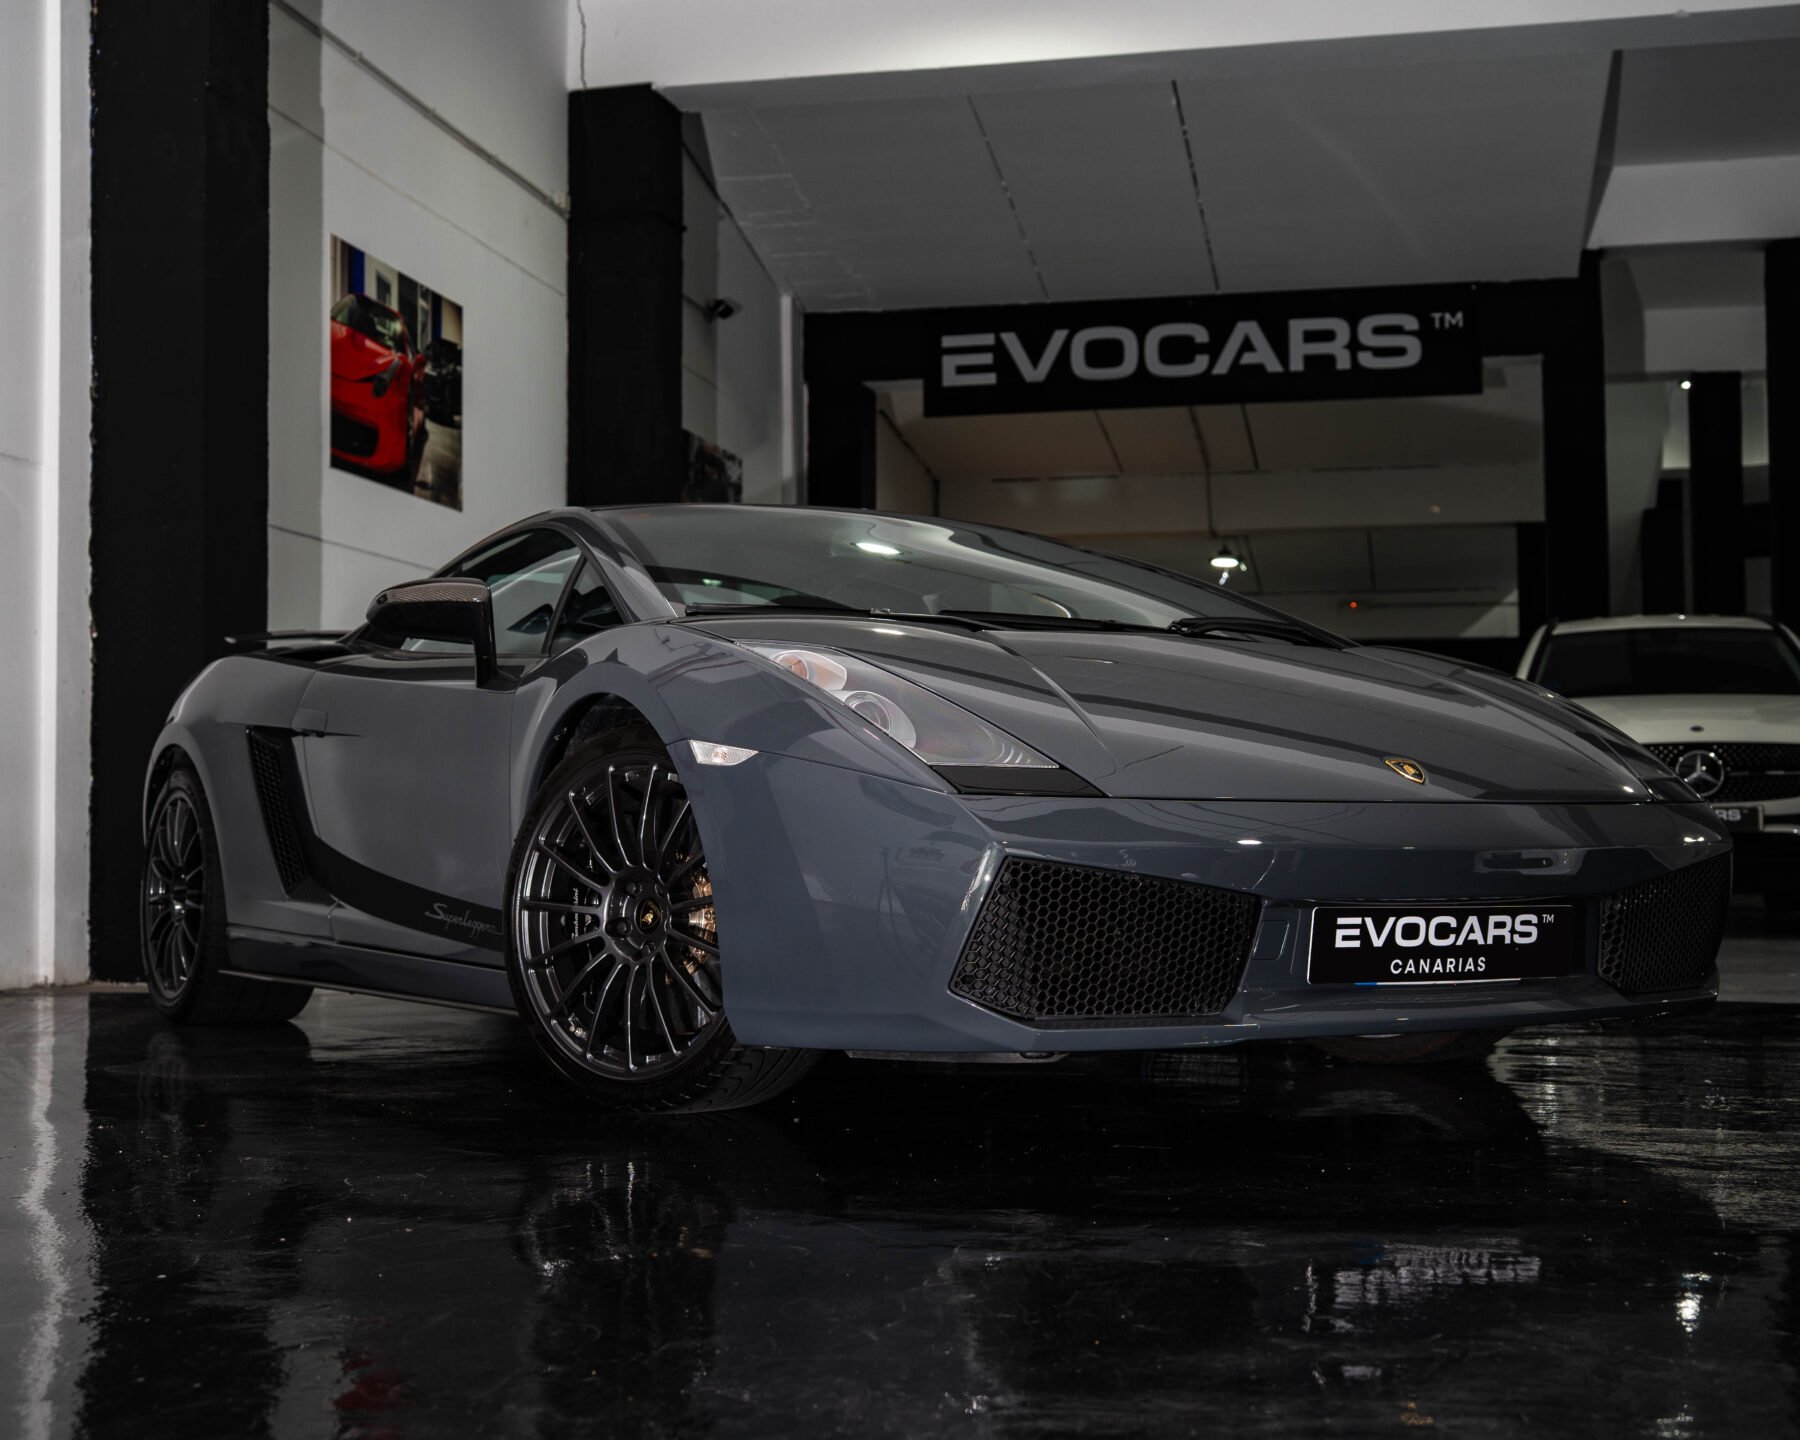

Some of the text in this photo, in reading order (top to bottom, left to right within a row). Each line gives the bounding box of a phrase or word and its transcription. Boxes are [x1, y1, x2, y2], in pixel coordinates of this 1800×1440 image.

[941, 313, 1422, 387] EVOCARS
[1334, 914, 1538, 948] EVOCARS
[1390, 956, 1486, 975] CANARIAS
